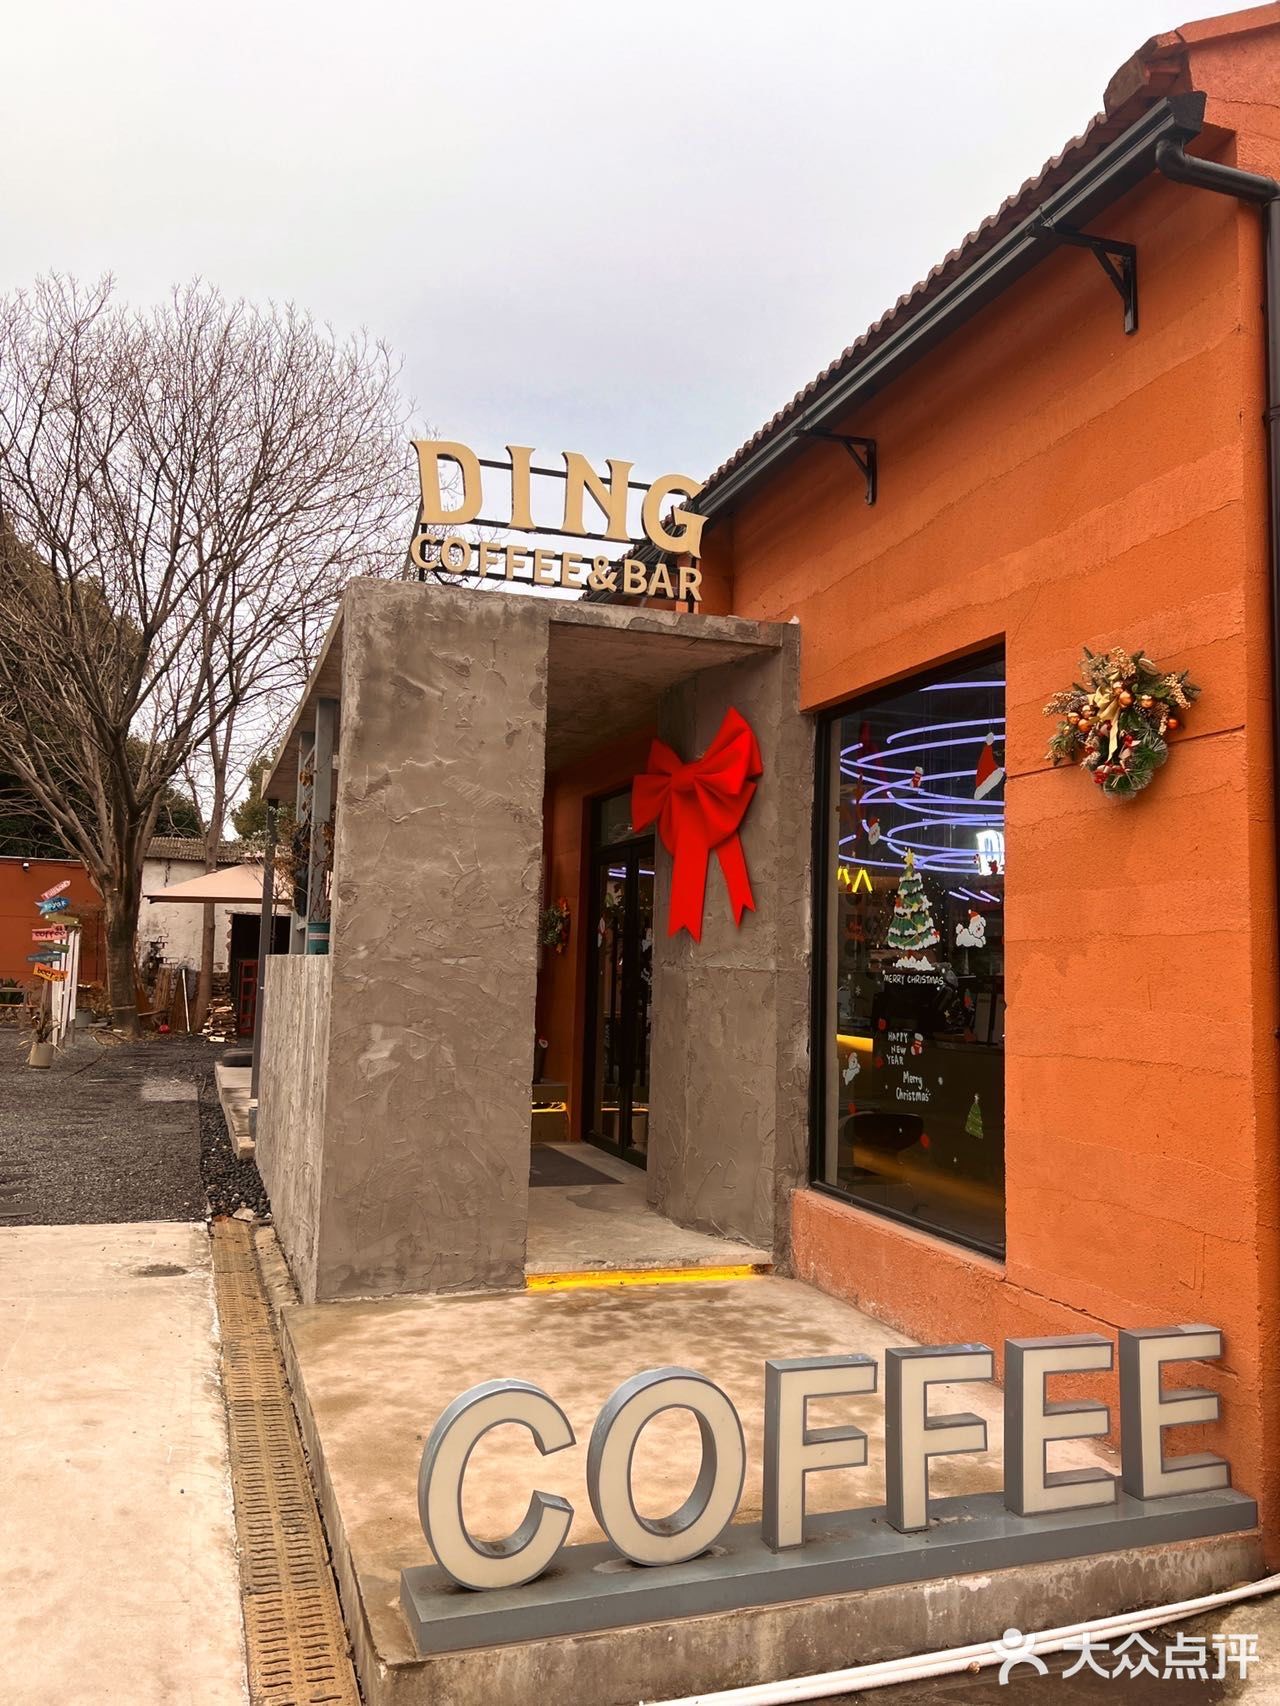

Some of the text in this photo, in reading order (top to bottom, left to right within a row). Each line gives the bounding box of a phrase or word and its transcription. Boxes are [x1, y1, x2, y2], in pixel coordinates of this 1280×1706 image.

[409, 440, 709, 560] DING
[410, 532, 703, 602] COFFEE&BAR
[884, 974, 944, 986] MERRY CHRISTMAS
[888, 1032, 908, 1043] HAPPY
[891, 1046, 907, 1055] NEW
[886, 1054, 904, 1065] YEAR
[903, 1071, 923, 1090] Merry
[896, 1087, 929, 1102] Christmas
[418, 1324, 1232, 1592] COFFEE
